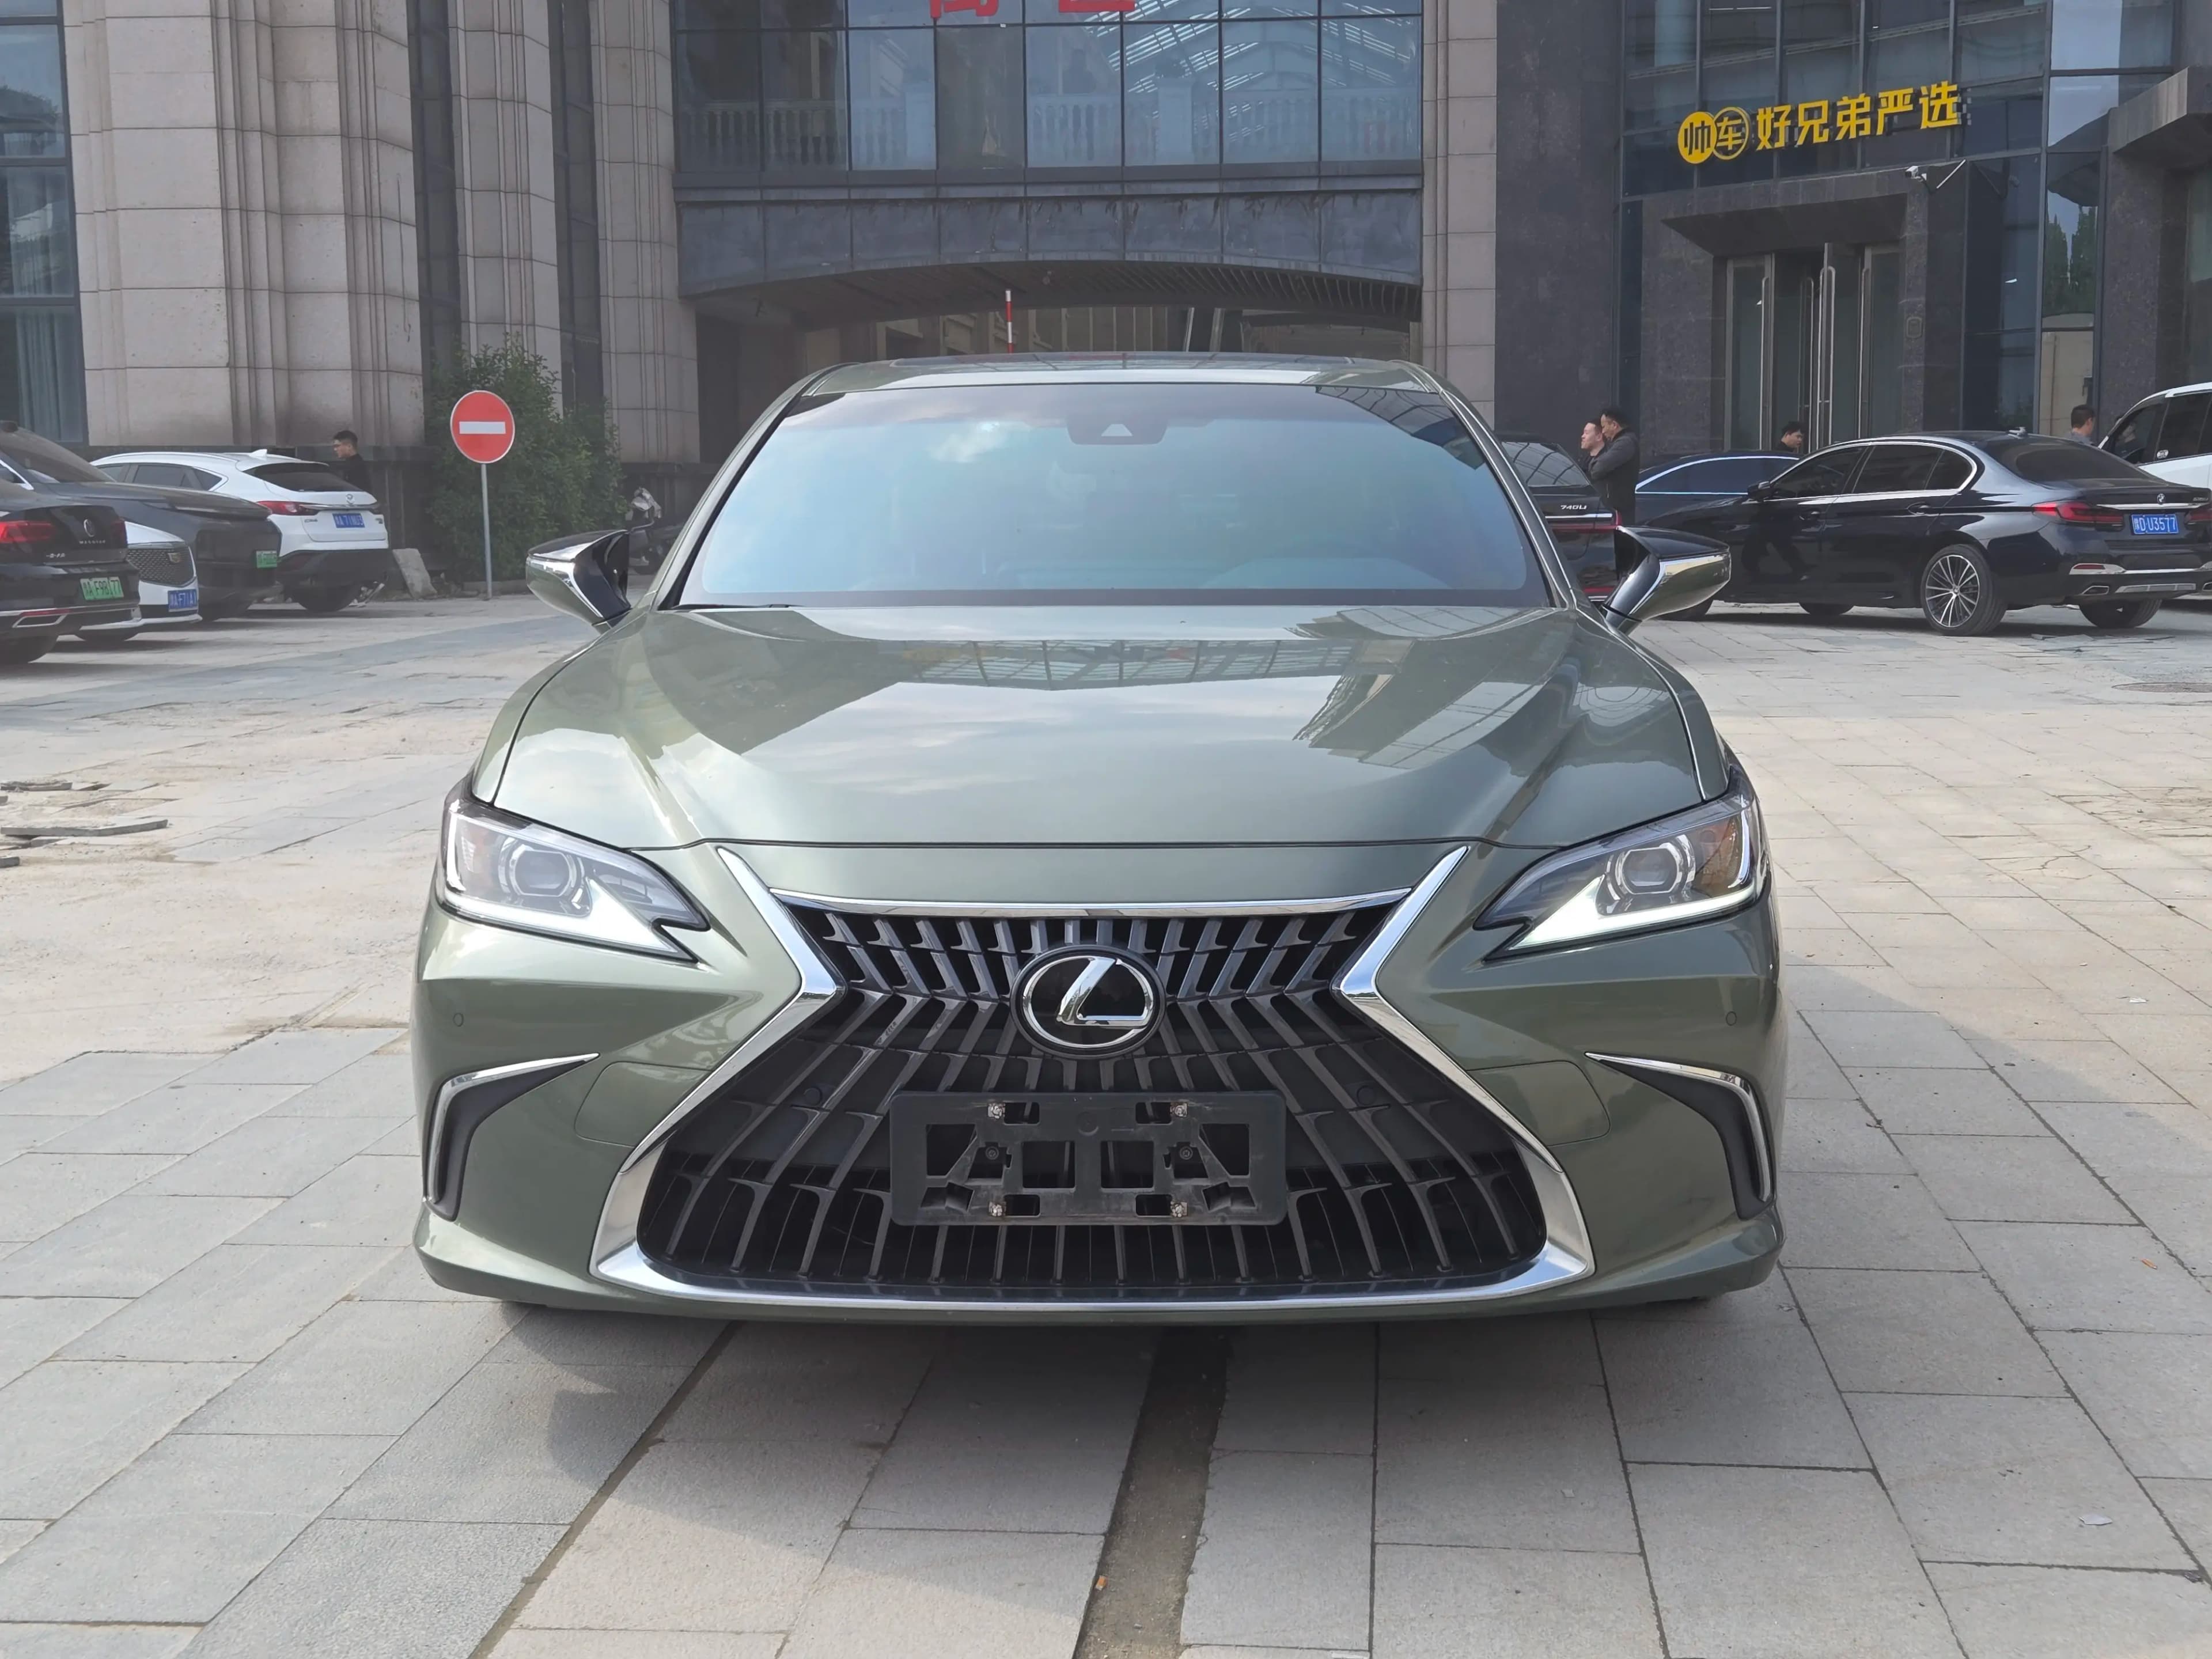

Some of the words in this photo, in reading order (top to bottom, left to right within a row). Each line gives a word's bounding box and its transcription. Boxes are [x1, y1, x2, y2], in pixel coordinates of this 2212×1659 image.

[1756, 81, 1962, 151] 好兄弟严选
